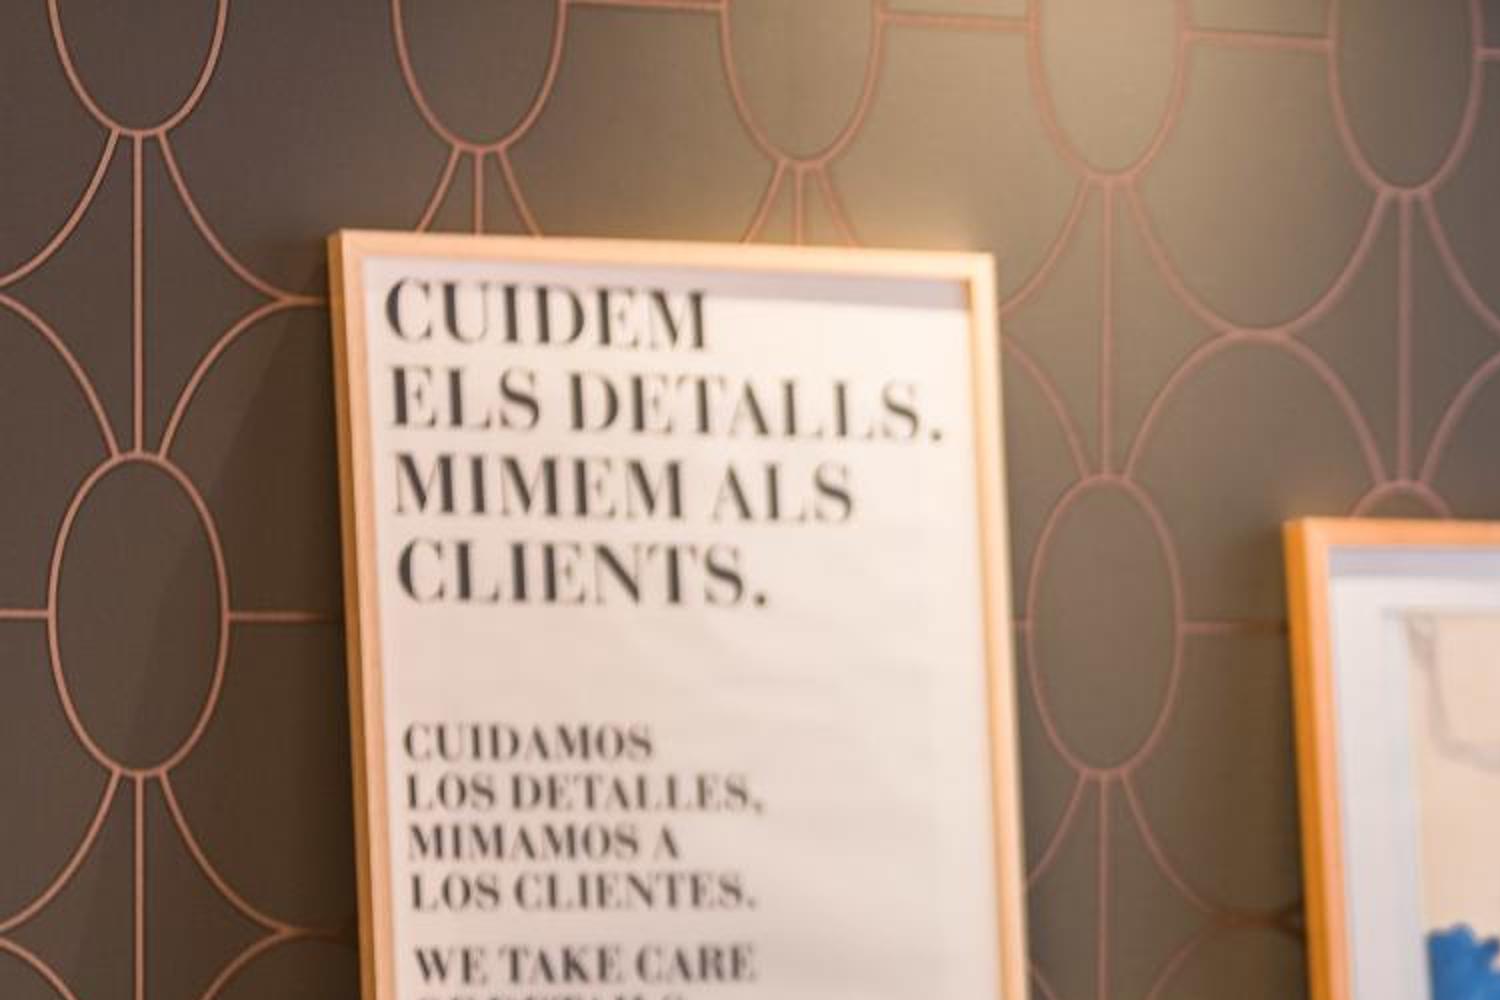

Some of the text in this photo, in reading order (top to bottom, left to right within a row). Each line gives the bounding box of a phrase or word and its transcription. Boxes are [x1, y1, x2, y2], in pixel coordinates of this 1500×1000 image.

[384, 277, 709, 351] CUIDEM
[389, 364, 945, 442] ELS DETALLS.
[394, 450, 855, 523] MIMEM ALS
[396, 537, 767, 608] CLIENTS.
[402, 722, 654, 763] CUIDAMOS
[406, 771, 763, 814] LOS DETALLES,
[408, 822, 682, 862] MIMAMOS A
[411, 872, 501, 912] LOS
[413, 943, 756, 986] WE TAKE CARE
